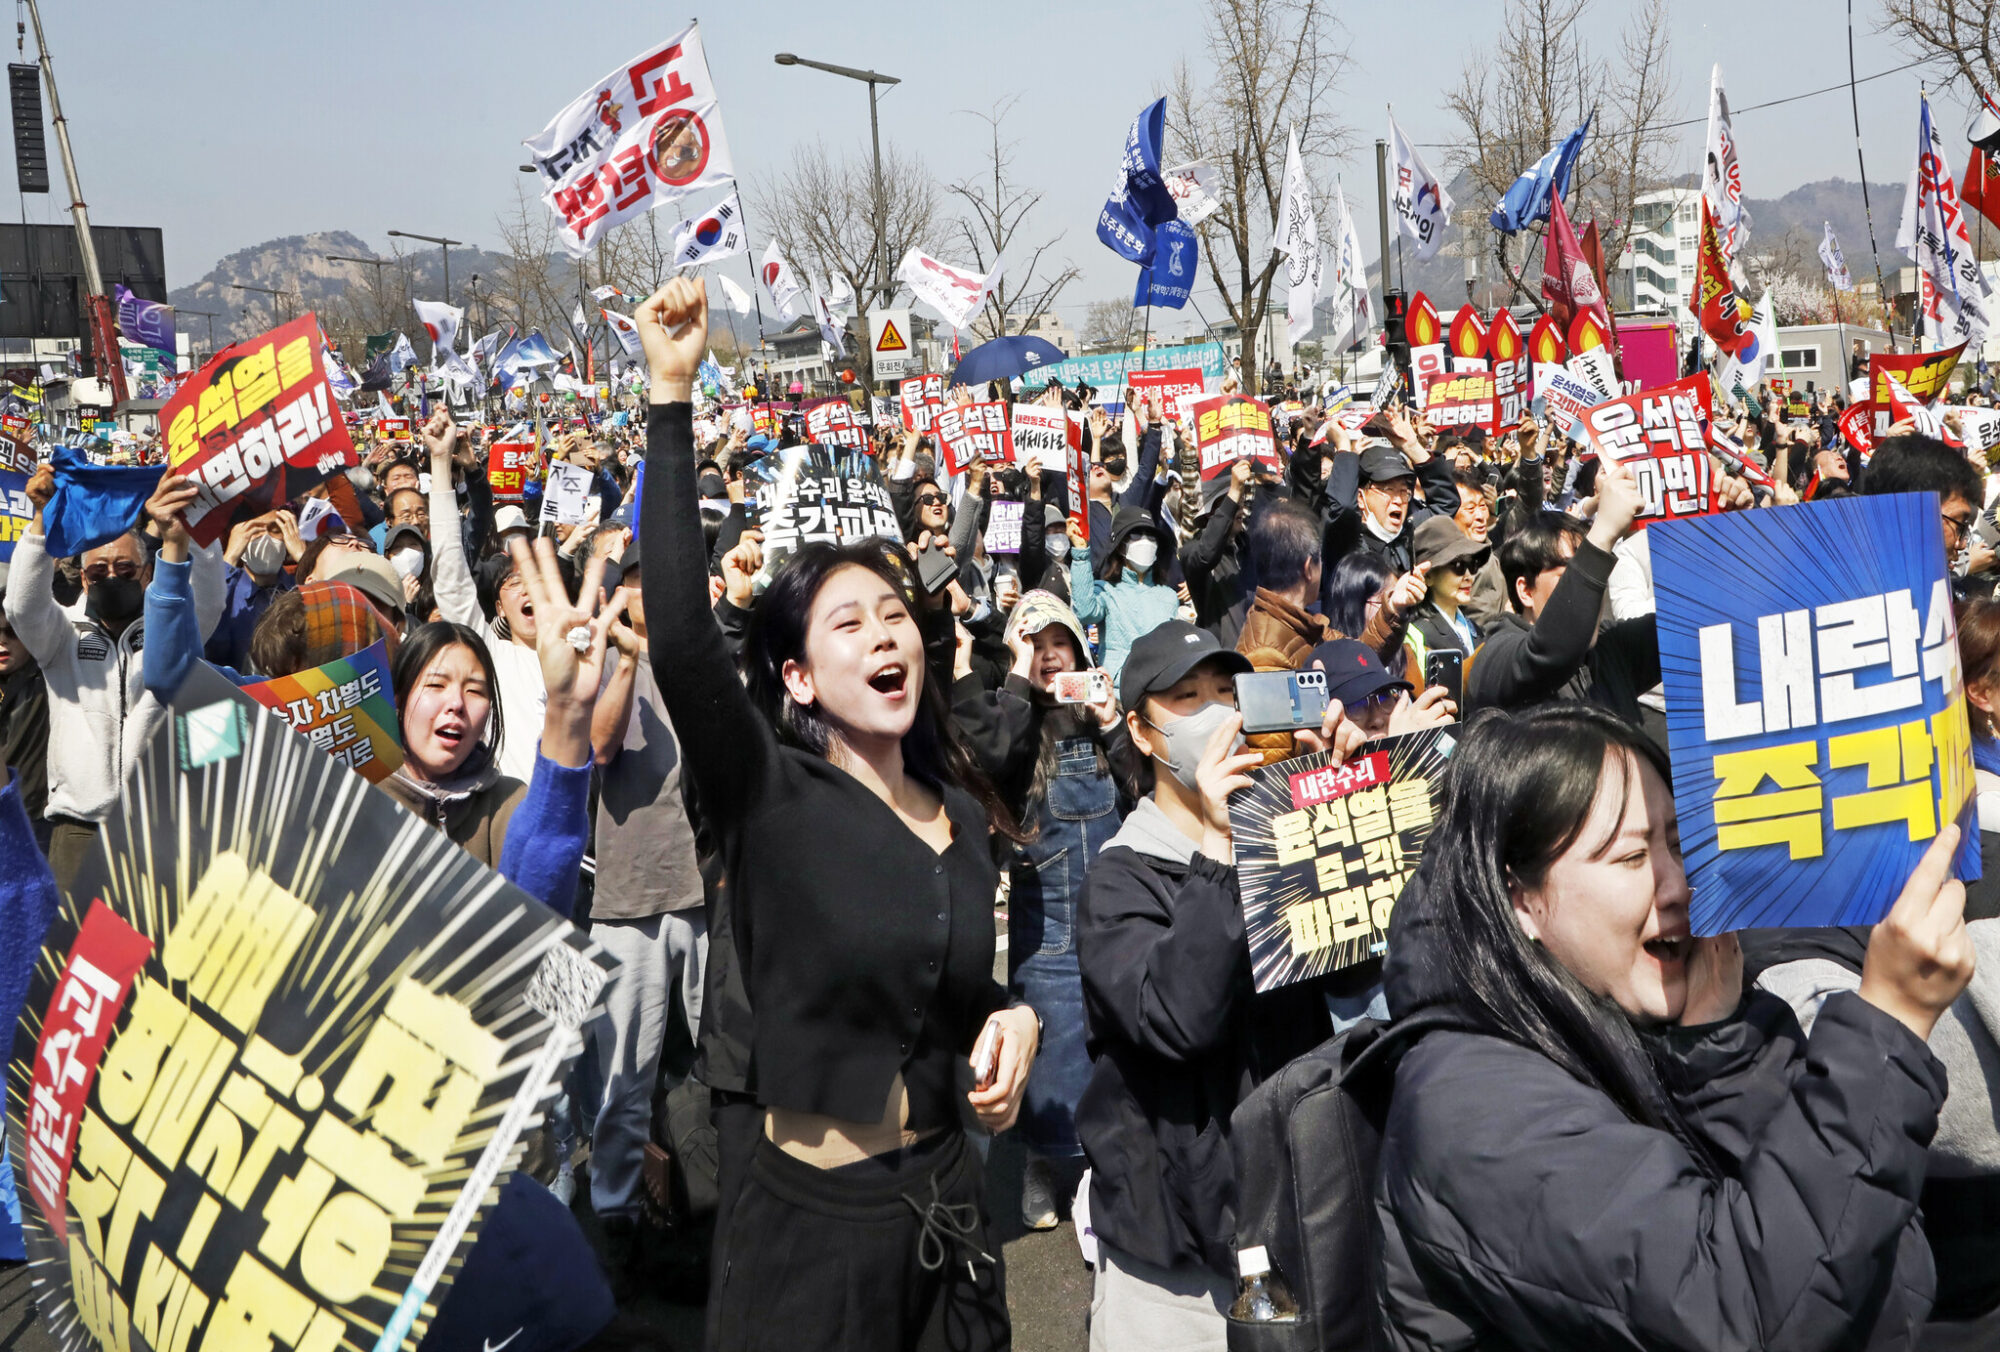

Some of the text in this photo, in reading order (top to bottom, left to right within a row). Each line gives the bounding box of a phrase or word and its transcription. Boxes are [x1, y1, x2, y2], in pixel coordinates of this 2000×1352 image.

[878, 362, 905, 373] 우회전
[167, 335, 314, 470] 윤석열을
[1550, 374, 1597, 407] 윤석열은
[938, 404, 1007, 444] 윤석열
[1015, 414, 1047, 427] 내란동조
[1199, 402, 1270, 443] 윤석열을
[1590, 394, 1707, 461] 윤석열
[950, 434, 1005, 469] 파면!
[1200, 433, 1276, 471] 파면하라!
[1624, 453, 1709, 519] 파면!
[316, 668, 382, 719] 차별도
[302, 713, 358, 752] 열도
[1299, 758, 1375, 801] 내란수괴
[1272, 778, 1433, 868] 윤석열을
[27, 954, 121, 1209] 내란수괴
